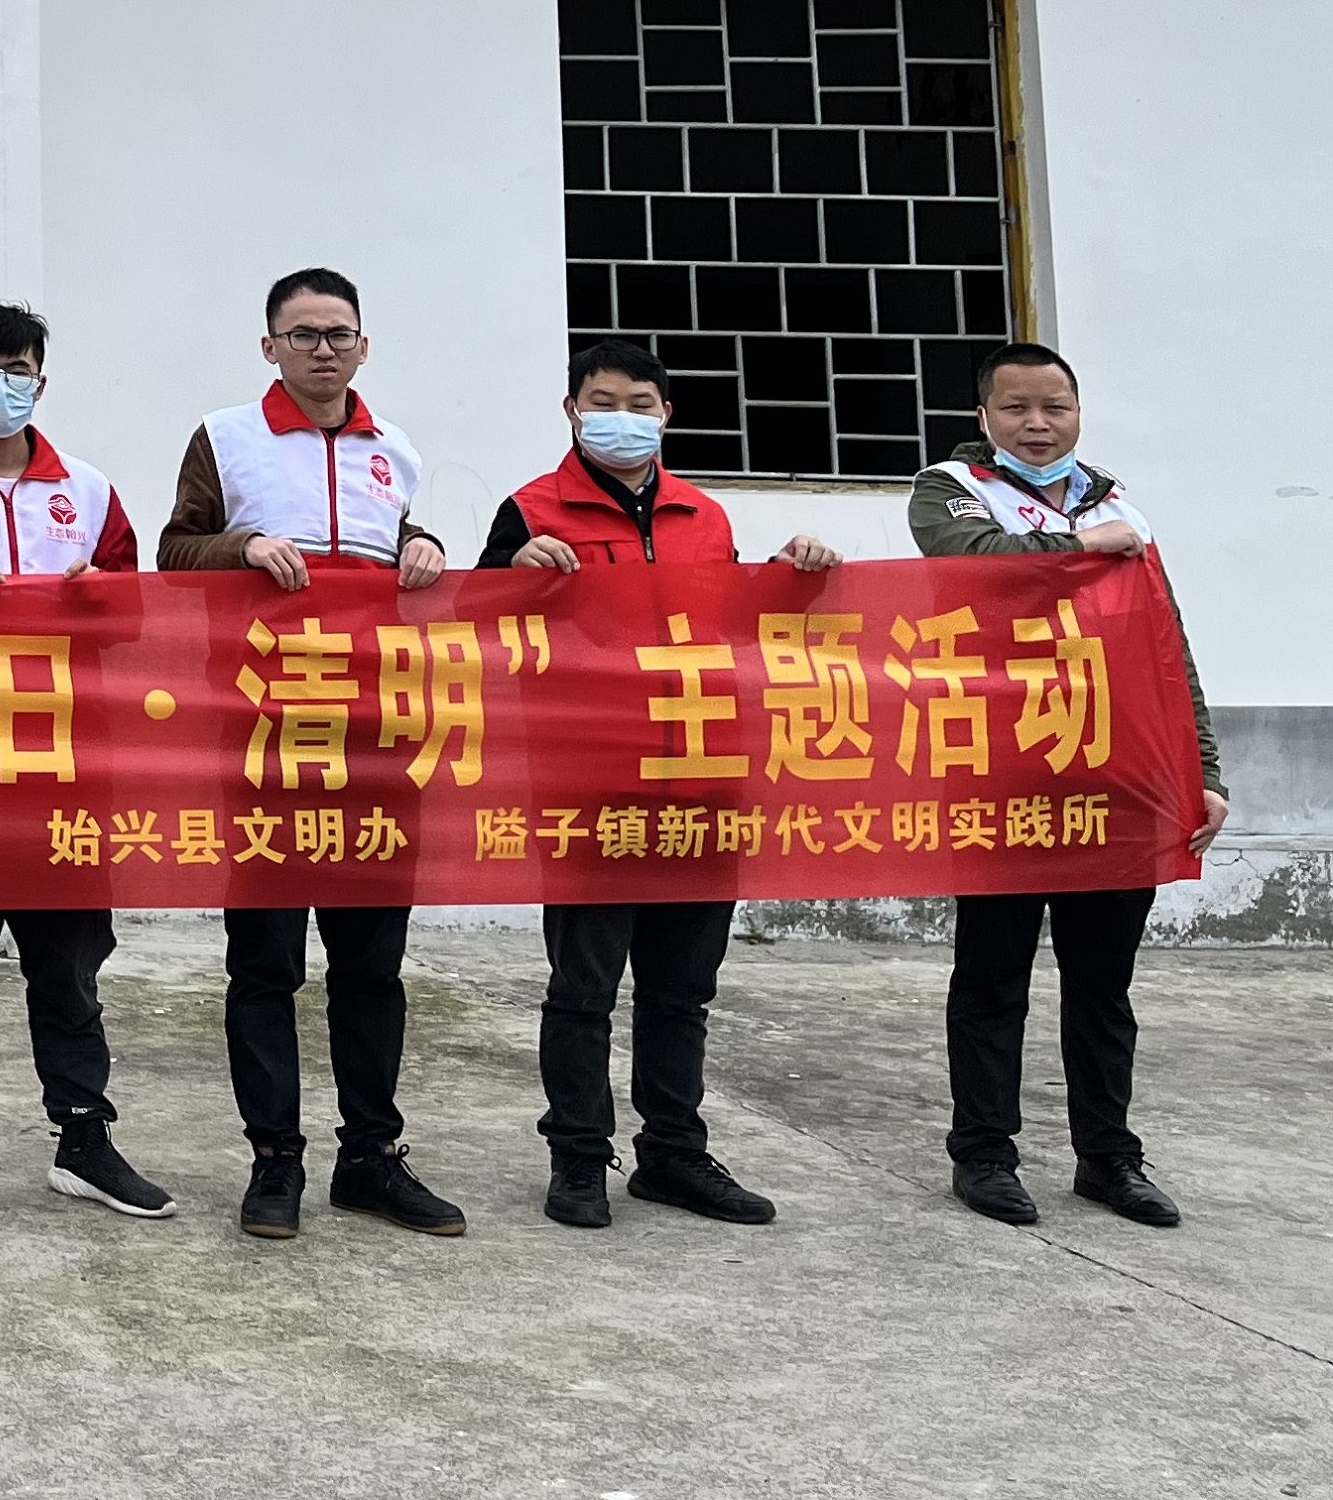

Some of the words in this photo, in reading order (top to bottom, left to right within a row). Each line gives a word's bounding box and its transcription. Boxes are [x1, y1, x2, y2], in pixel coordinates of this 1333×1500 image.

[47, 806, 408, 866] 始兴县文明办
[475, 793, 1110, 861] 隘子镇新时代文明实践所
